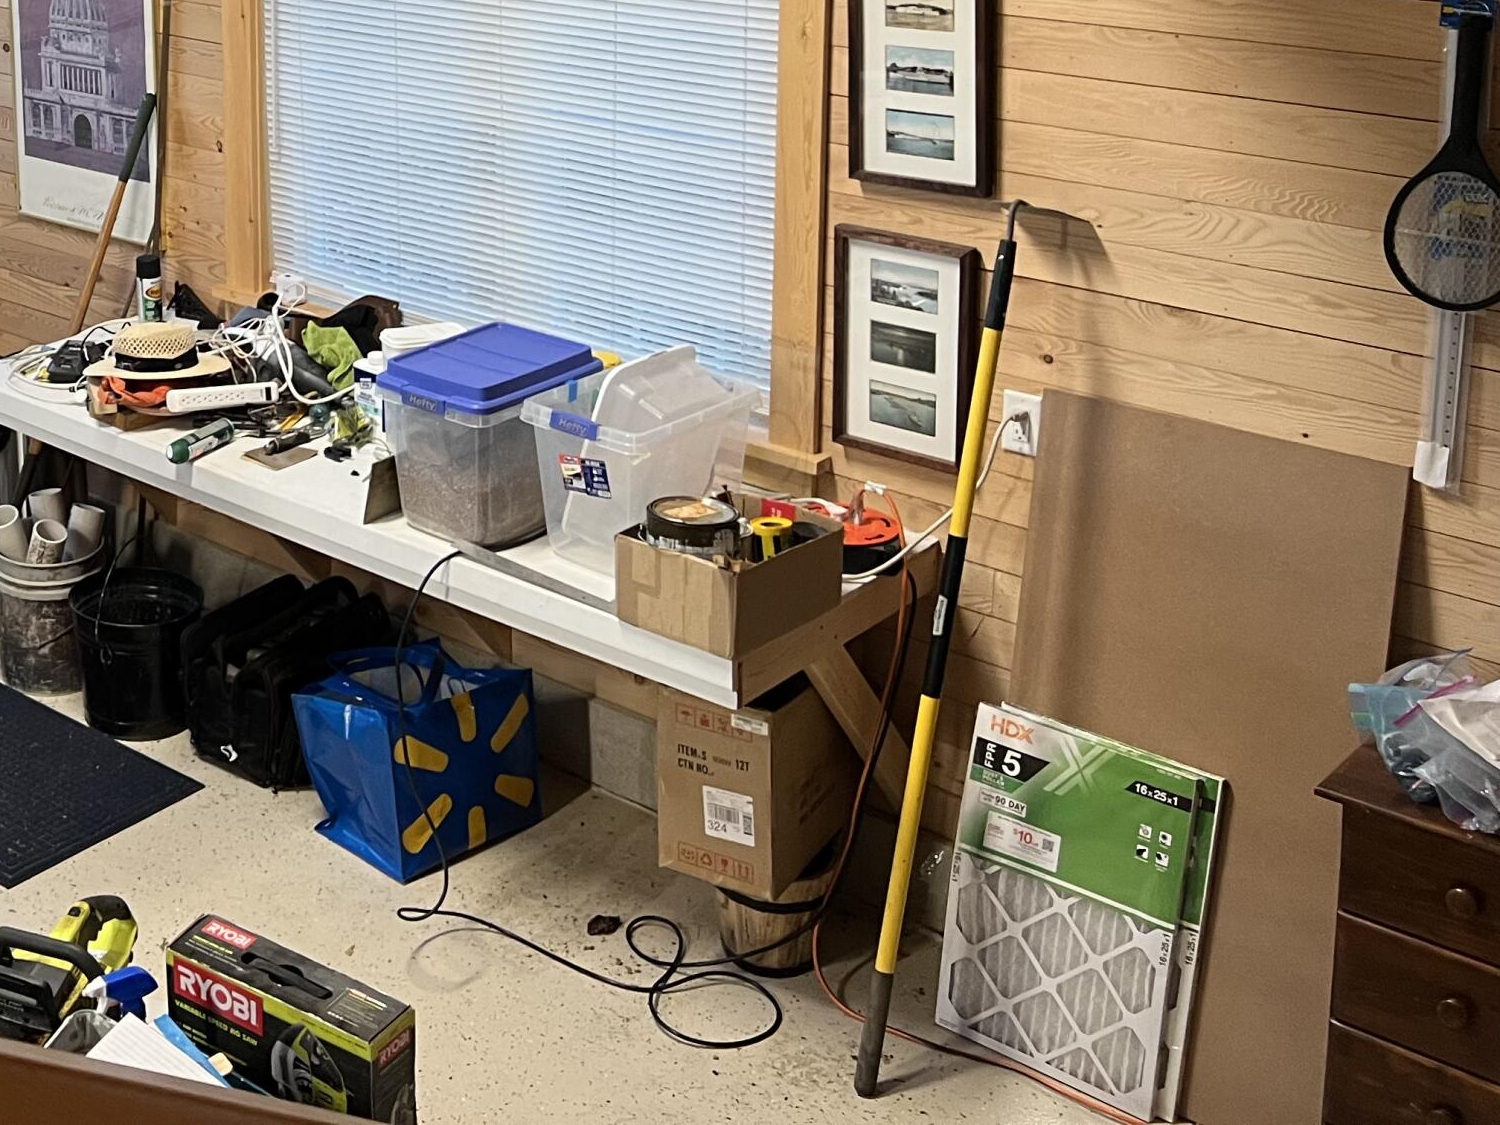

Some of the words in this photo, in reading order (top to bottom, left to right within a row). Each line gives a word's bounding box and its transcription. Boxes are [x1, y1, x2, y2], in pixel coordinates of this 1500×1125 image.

[409, 394, 437, 412] Hefty
[558, 417, 588, 436] Hefty
[990, 714, 1035, 744] HDX
[984, 743, 997, 768] FPR
[1001, 750, 1021, 777] 5
[995, 794, 1006, 805] 90
[1008, 797, 1026, 813] DAY
[1135, 783, 1178, 806] 16x25x1
[707, 819, 727, 833] 324
[208, 921, 250, 947] RYOBI
[177, 965, 258, 1025] RYOBI
[379, 1030, 411, 1066] RYOBI
